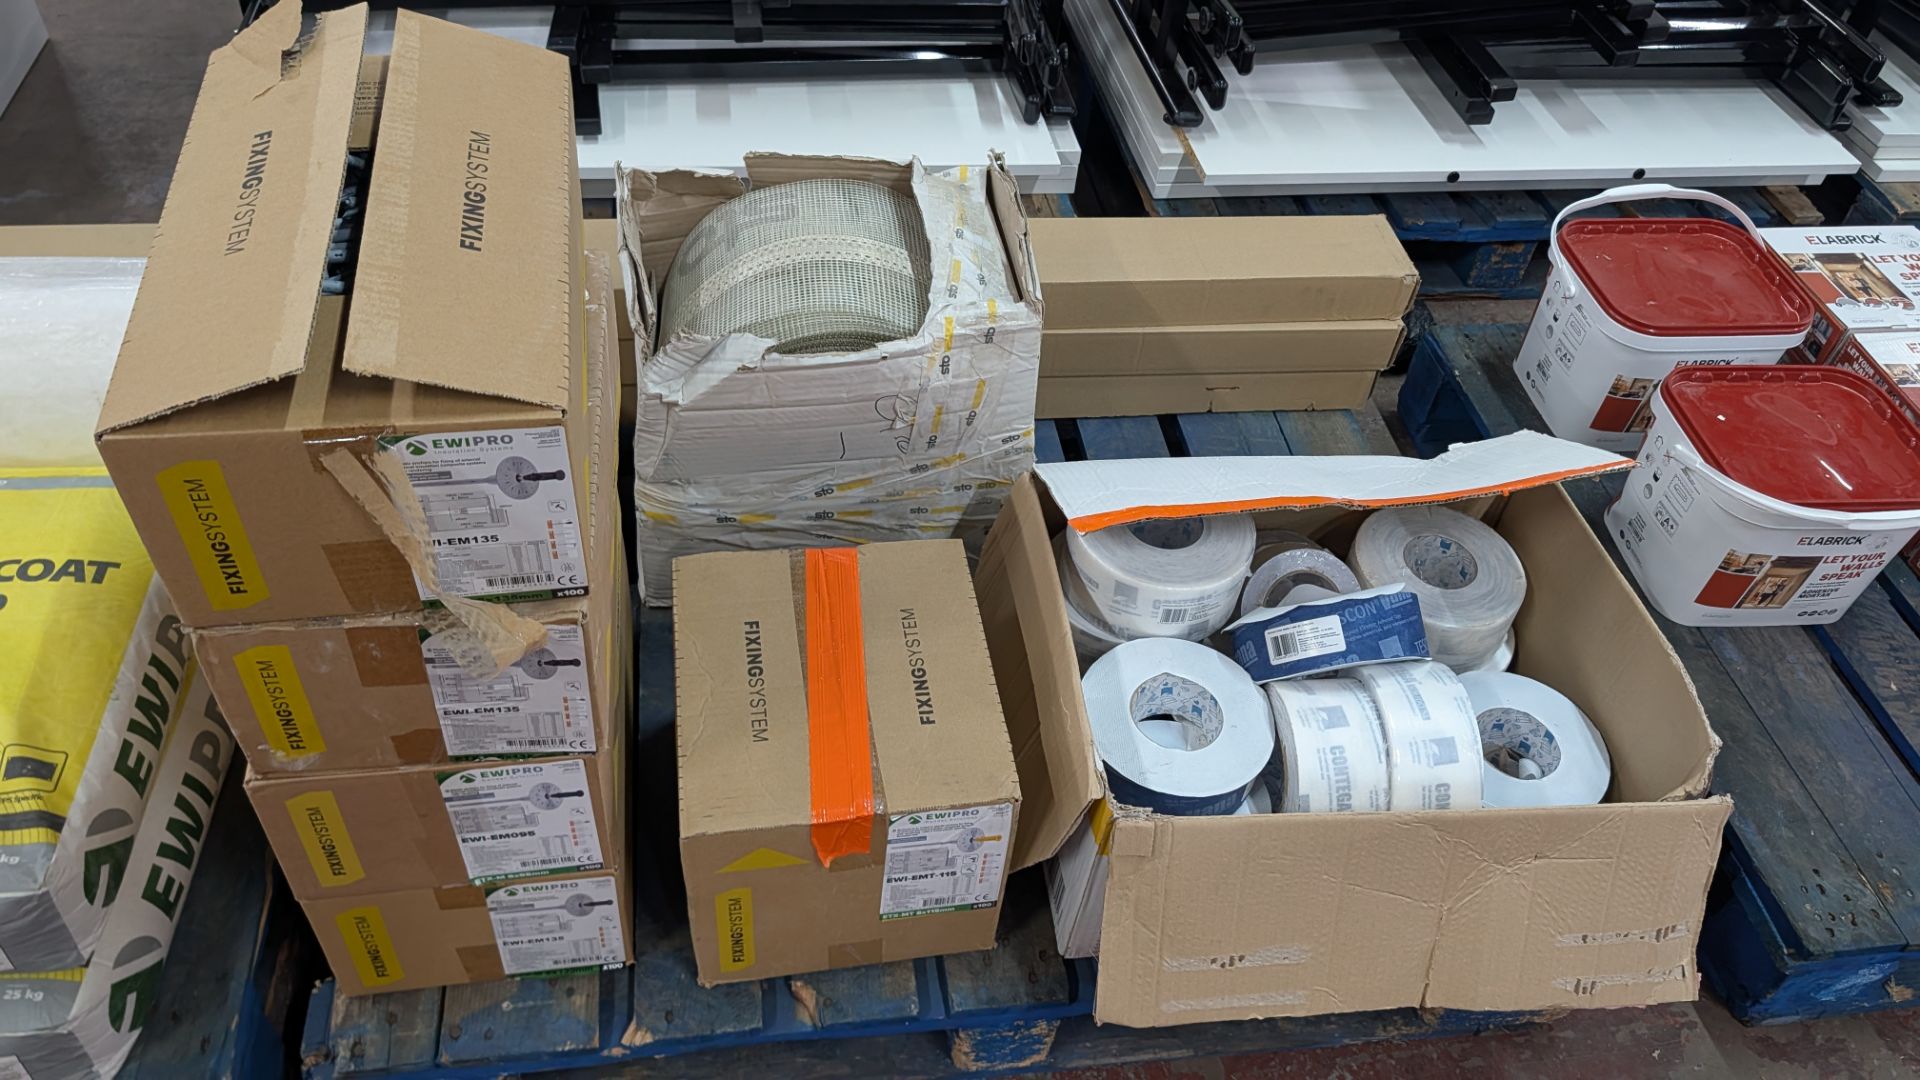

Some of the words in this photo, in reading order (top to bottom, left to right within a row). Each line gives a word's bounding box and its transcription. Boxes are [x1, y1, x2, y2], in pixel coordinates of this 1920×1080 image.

[224, 130, 273, 257] FIXINGSYSTEM
[459, 130, 491, 252] FIXINGSYSTEM
[1804, 234, 1886, 245] ELABRICK
[1869, 255, 1898, 264] LET
[984, 326, 996, 344] sto
[940, 355, 951, 376] sto
[432, 434, 514, 450] EWIPRO
[1001, 434, 1021, 445] sto
[814, 486, 834, 498] sto
[953, 483, 973, 492] sto
[909, 506, 929, 514] sto
[716, 515, 737, 524] sto
[183, 478, 248, 596] FIXINGSYSTEM
[1796, 536, 1867, 546] ELABRICK
[1822, 555, 1850, 564] LET
[1850, 552, 1886, 562] YOUR
[1840, 560, 1886, 572] WALLS
[1818, 570, 1864, 581] SPEAK
[556, 589, 585, 597] x100
[900, 607, 936, 726] FIXINGSYSTEM
[744, 620, 770, 744] FIXINGSYSTEM
[256, 660, 306, 751] FIXINGSYSTEM
[444, 706, 520, 716] EWI-EM135
[480, 766, 544, 778] EWIPRO
[926, 809, 980, 820] EWIPRO
[306, 806, 347, 877] FIXINGSYSTEM
[461, 830, 536, 844] EWI-EM095
[522, 882, 580, 893] EWIPRO
[731, 896, 746, 964] FIXINGSYSTEM
[354, 916, 390, 978] FIXINGSYSTEM
[4, 989, 22, 1000] 25
[25, 988, 44, 1002] kg
